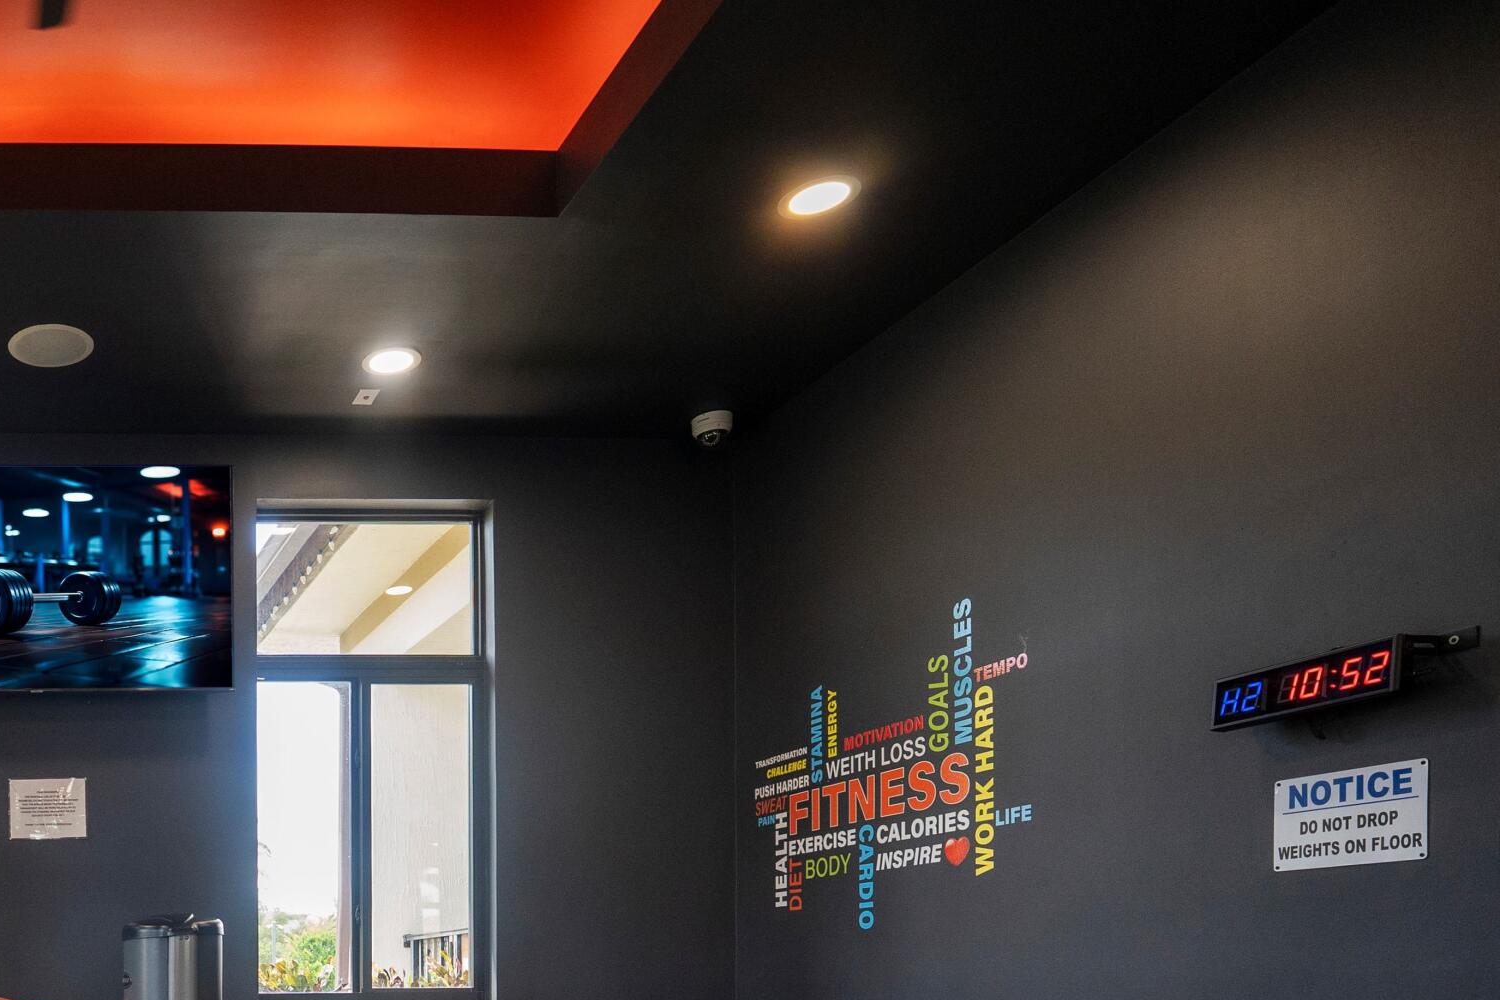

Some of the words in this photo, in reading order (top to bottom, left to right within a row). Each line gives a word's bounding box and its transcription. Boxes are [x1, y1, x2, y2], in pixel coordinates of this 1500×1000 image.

[953, 598, 973, 746] MUSCLES
[973, 653, 1028, 682] TEMPO
[1289, 651, 1391, 702] 10:52
[927, 654, 949, 752] GOALS
[810, 685, 823, 784] STAMINA
[827, 690, 838, 759] ENERGY
[843, 715, 925, 752] MOTIVATION
[974, 685, 994, 774] HARD
[755, 746, 808, 769] TRANSFORMATION
[766, 758, 808, 779] CHALLENGE
[826, 749, 876, 780] WEITH
[881, 736, 926, 767] LOSS
[754, 783, 775, 801] PUSH
[776, 774, 810, 794] HARDER
[755, 794, 788, 817] SWEAT
[788, 752, 971, 836] FITNESS
[1288, 767, 1413, 810] NOTICE
[757, 814, 776, 827] PAIN
[876, 809, 970, 845] CALORIES
[975, 777, 995, 877] WORK
[995, 804, 1032, 827] LIFE
[1300, 820, 1318, 836] DO
[1322, 815, 1352, 833] NOT
[1357, 810, 1399, 829] DROP
[775, 811, 788, 908] HEALTH
[788, 828, 857, 857] EXERCISE
[876, 843, 943, 872] INSPIRE
[1278, 841, 1340, 861] WEIGHTS
[1344, 838, 1367, 855] ON
[1371, 832, 1423, 852] FLOOR
[789, 857, 803, 911] DIET
[805, 852, 852, 880] BODY
[858, 824, 875, 930] CARDIO
